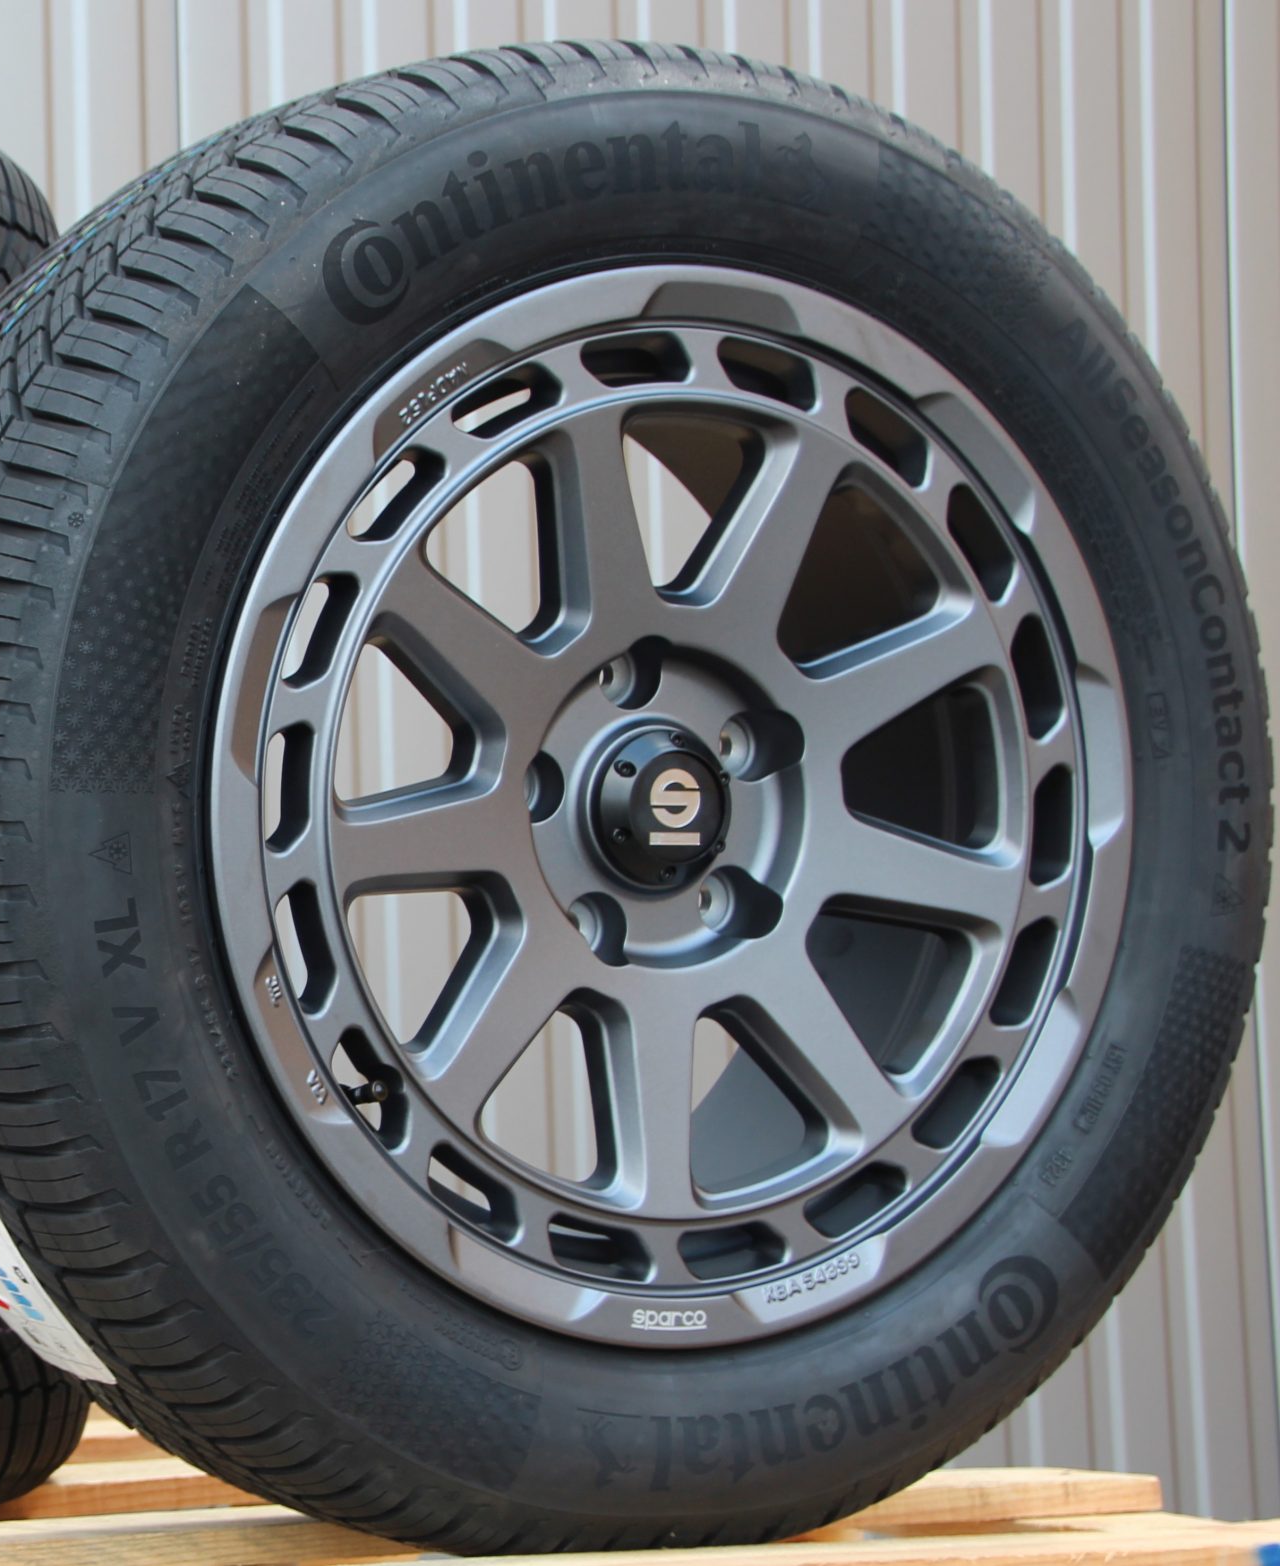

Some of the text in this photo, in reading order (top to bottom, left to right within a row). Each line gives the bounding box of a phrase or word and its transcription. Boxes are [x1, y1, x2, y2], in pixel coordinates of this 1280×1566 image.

[322, 120, 761, 325] Continental
[1055, 315, 1252, 804] AllSeasonContact
[1217, 819, 1251, 854] 2
[95, 897, 330, 1340] 235/55 R 17 V XL
[632, 1309, 707, 1330] sparco
[650, 1255, 1059, 1491] Continental
[762, 1253, 860, 1304] KBA 54399
